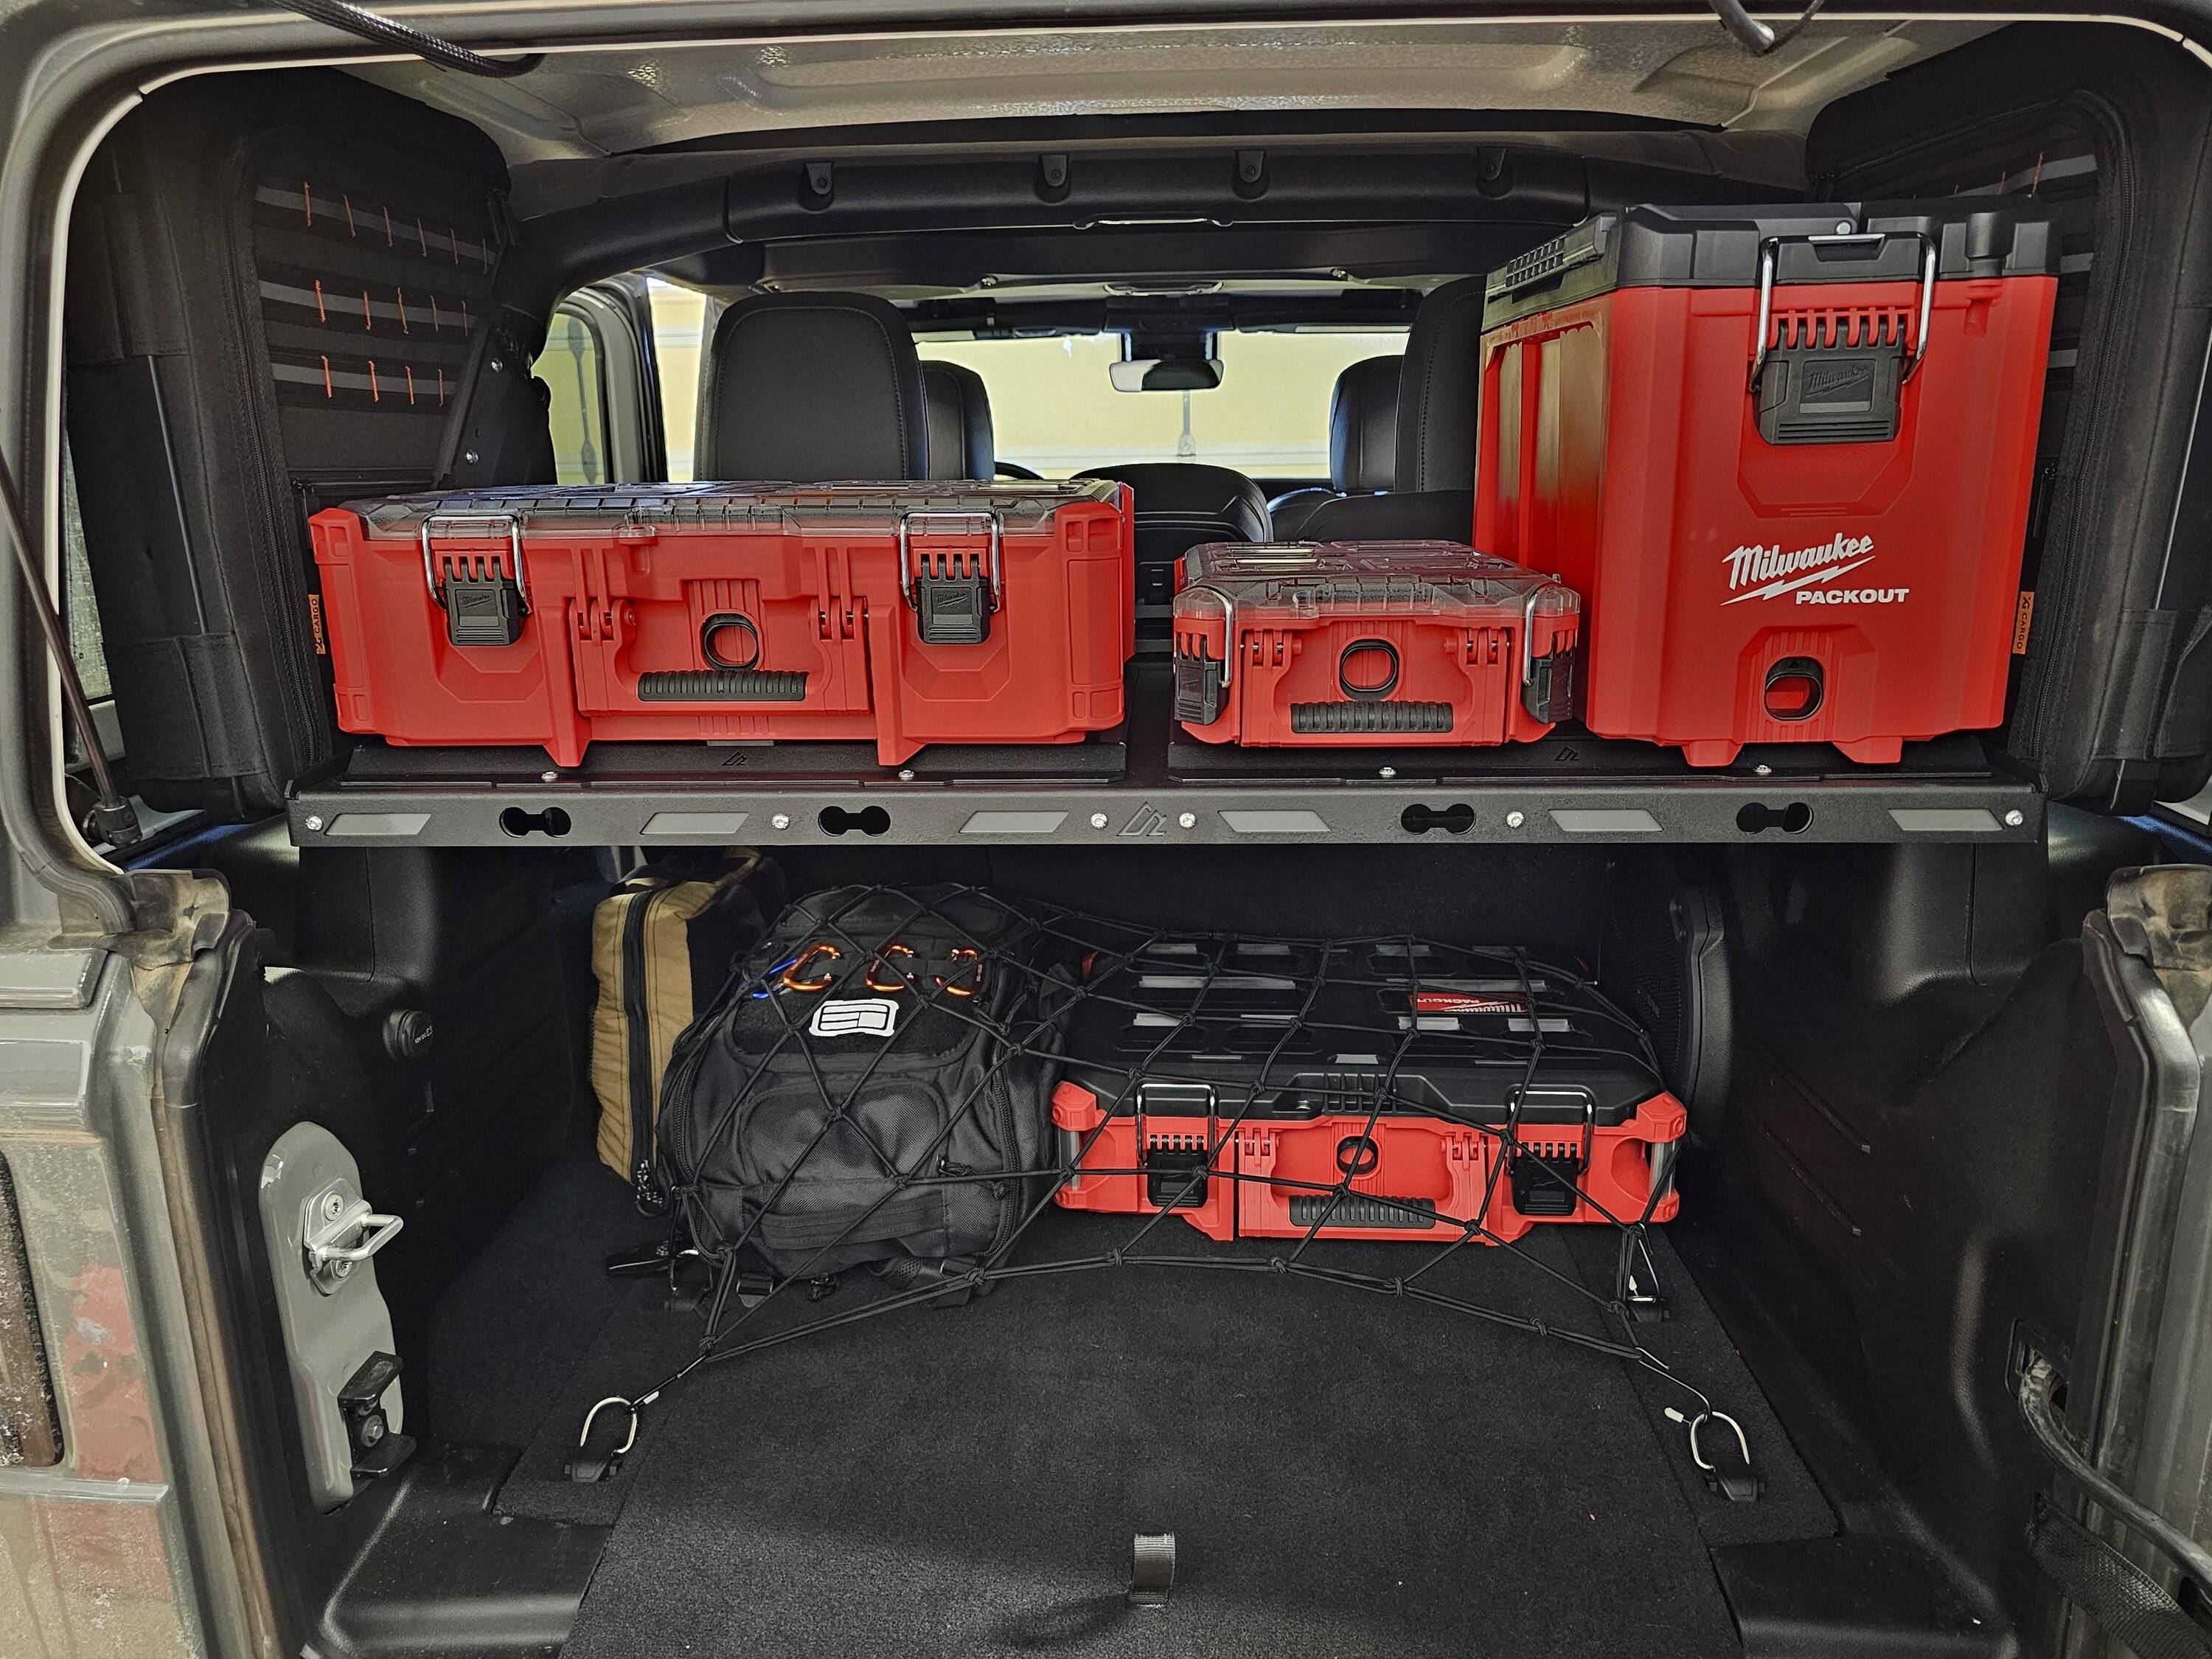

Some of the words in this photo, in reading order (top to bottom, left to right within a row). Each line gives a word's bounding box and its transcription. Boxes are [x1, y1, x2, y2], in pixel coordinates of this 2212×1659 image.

[1722, 532, 1875, 591] Milwaukee
[1795, 588, 1910, 605] PACKOUT
[311, 598, 321, 634] CARGO
[2017, 612, 2028, 650] CARGO
